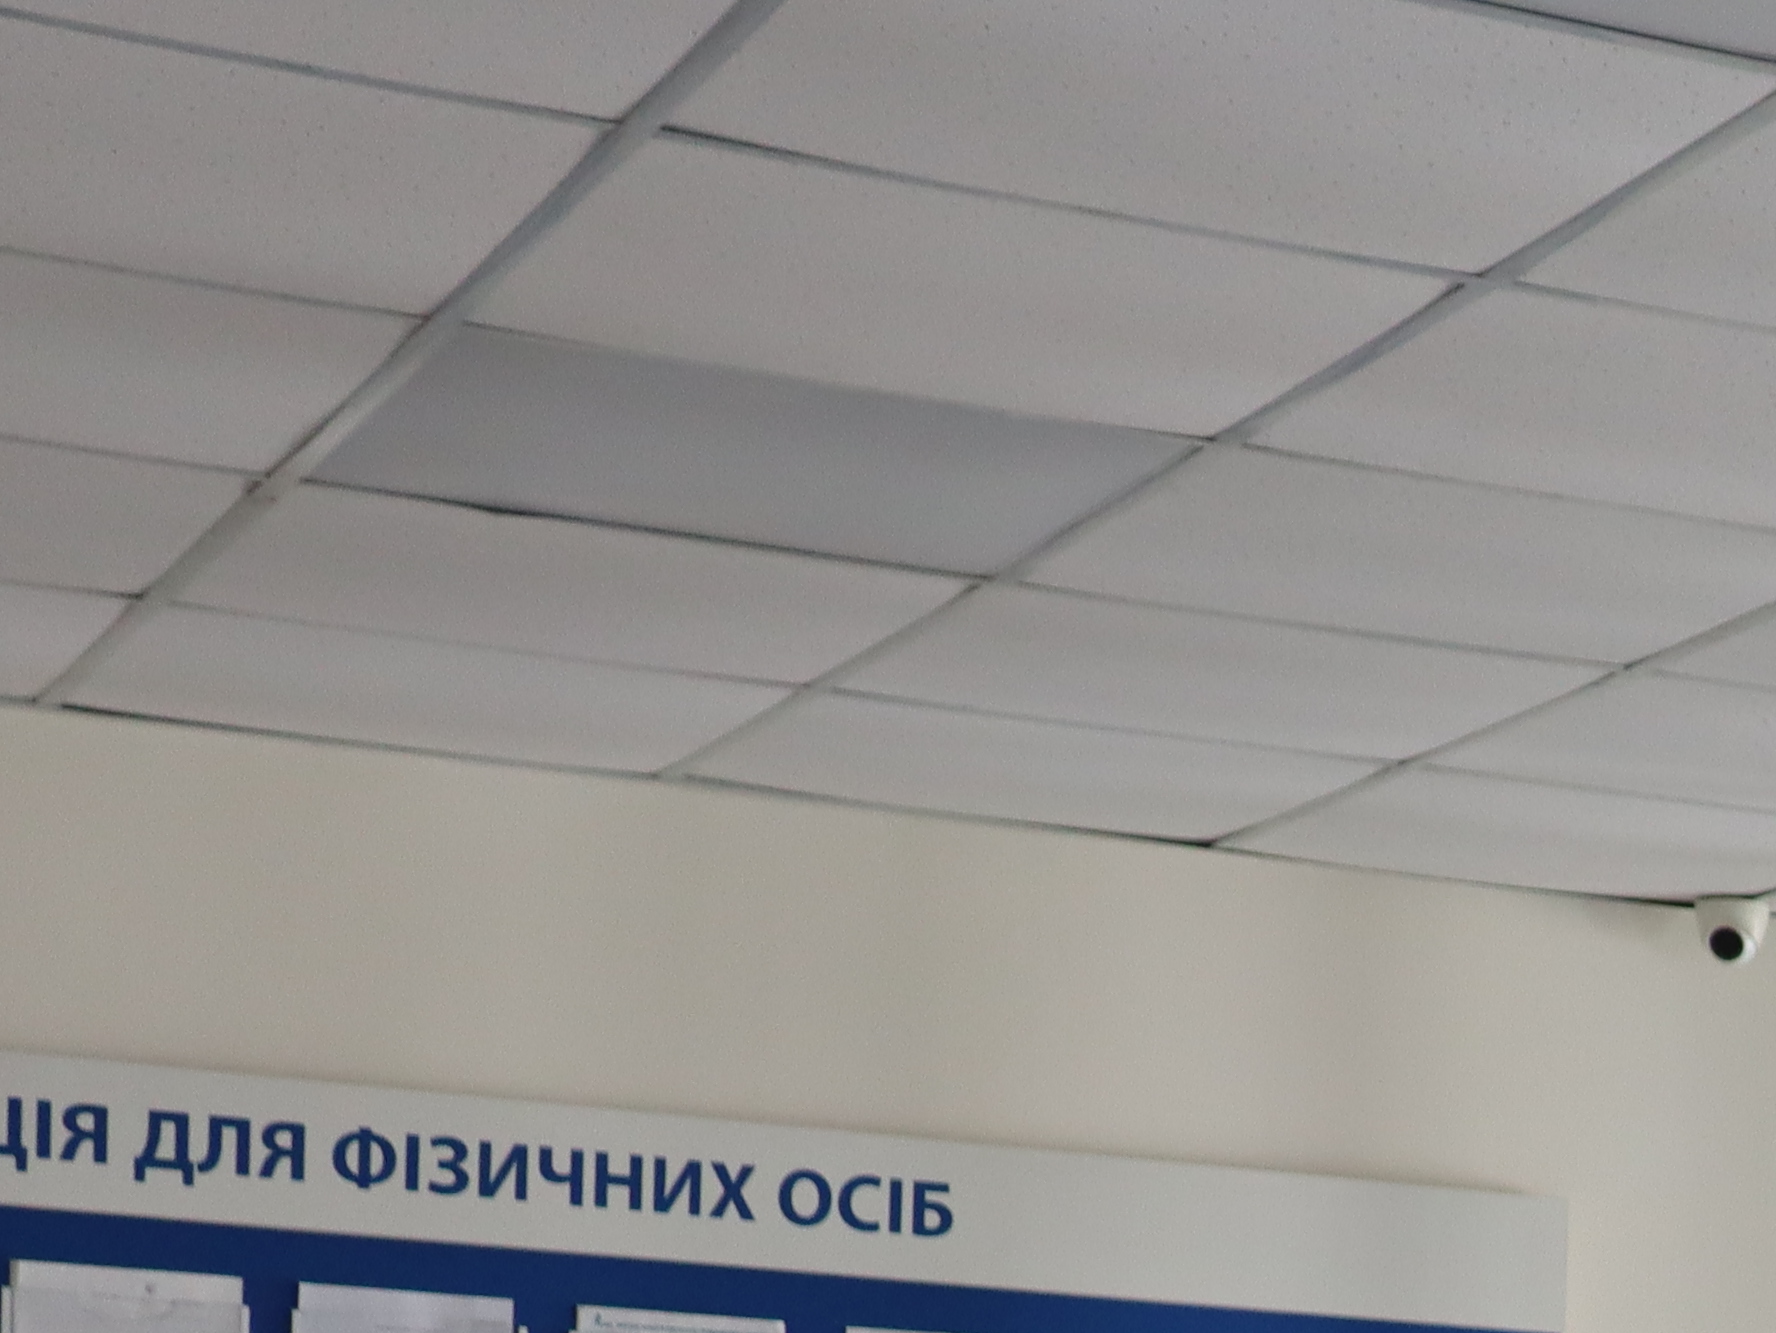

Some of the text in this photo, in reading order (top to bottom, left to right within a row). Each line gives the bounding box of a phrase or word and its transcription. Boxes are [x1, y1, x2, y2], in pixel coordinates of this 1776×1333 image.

[133, 1110, 306, 1186] ДЛЯ
[332, 1127, 755, 1221] ФІЗИЧНИХ
[778, 1169, 954, 1237] ОСІБ
